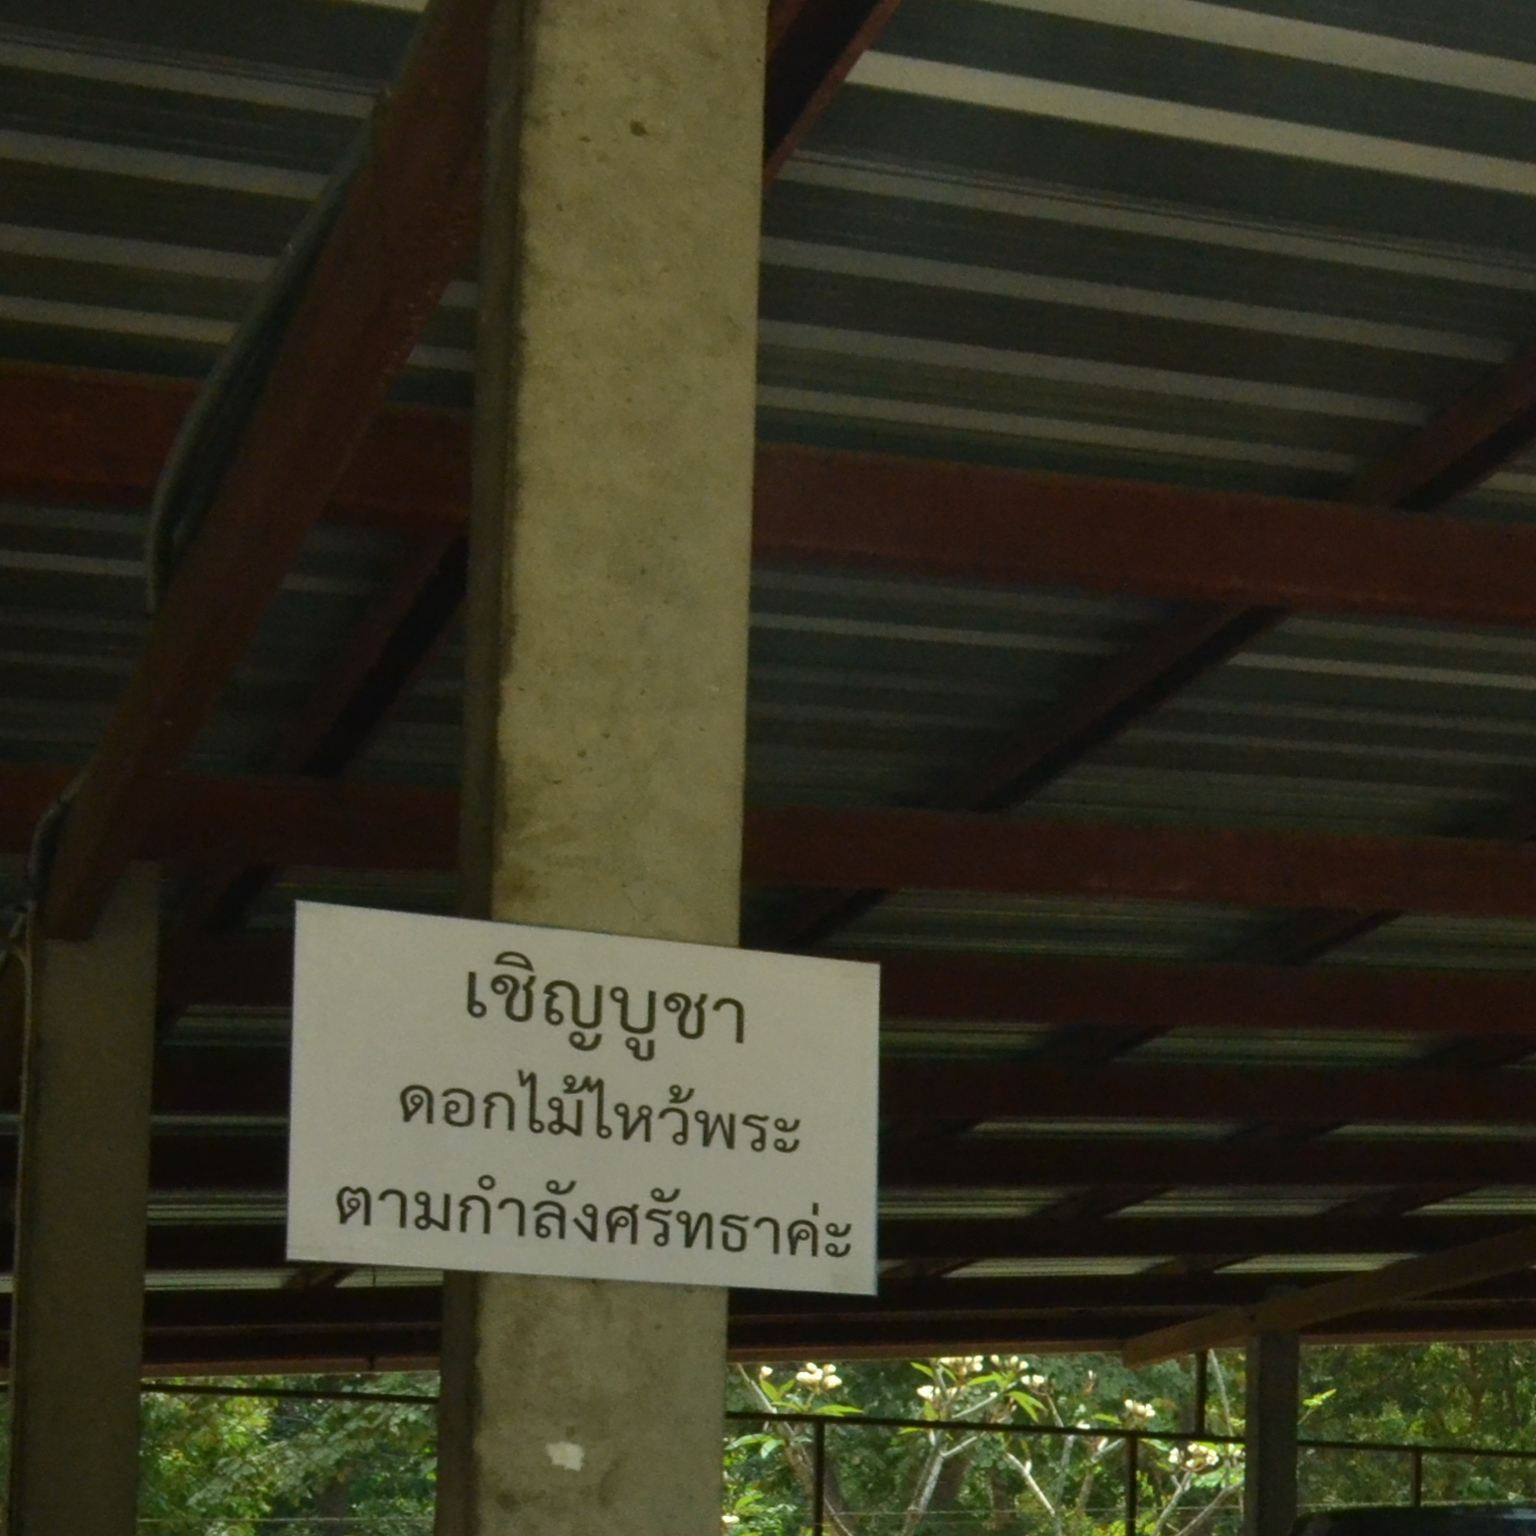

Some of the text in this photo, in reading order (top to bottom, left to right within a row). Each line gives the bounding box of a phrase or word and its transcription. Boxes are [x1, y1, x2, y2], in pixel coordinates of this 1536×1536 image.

[466, 951, 746, 1061] เชิญบูชา
[399, 1068, 801, 1153] ดอกไม้ไหว้พระ
[335, 1174, 852, 1259] ตามกำลังศรัทธาค่ะ
